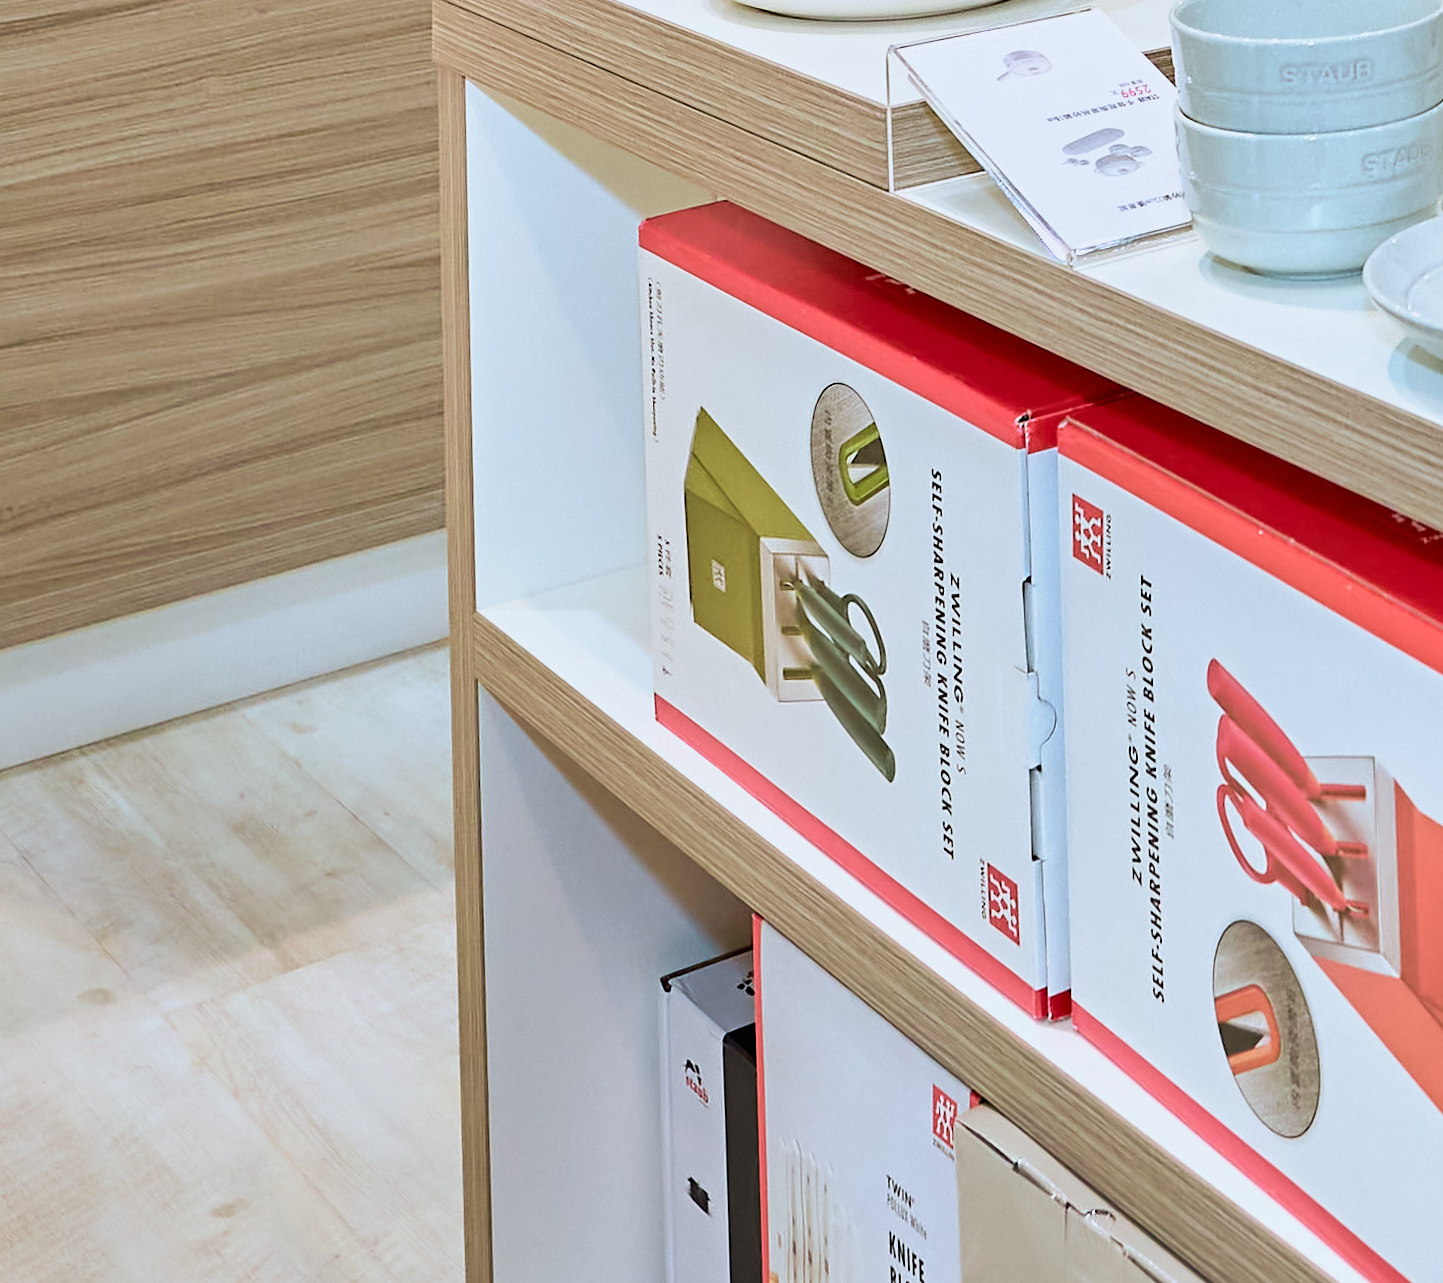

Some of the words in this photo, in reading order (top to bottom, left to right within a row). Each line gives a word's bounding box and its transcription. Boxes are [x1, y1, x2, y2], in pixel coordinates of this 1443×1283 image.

[1121, 83, 1152, 99] 2599
[1280, 58, 1374, 84] STAUB
[930, 468, 949, 666] SELF-SHARPENING
[1105, 514, 1113, 579] ZWILLING
[1140, 574, 1152, 620] SET
[950, 573, 964, 704] ZWILLING
[1126, 669, 1136, 679] S
[1142, 626, 1156, 701] BLOCK
[937, 673, 950, 735] KNIFE
[1126, 688, 1137, 727] NOW
[955, 717, 966, 757] NOW
[1144, 706, 1158, 780] KNIFE
[940, 737, 953, 809] BLOCK
[957, 763, 967, 775] S
[943, 820, 955, 860] SET
[1128, 746, 1143, 887] ZWILLING
[979, 858, 988, 920] ZWILLING
[1146, 788, 1165, 1003] SELF-SHARPENING
[685, 1076, 708, 1103] staub
[886, 1174, 913, 1209] TWIN
[887, 1193, 909, 1223] POLLUX
[889, 1231, 925, 1283] KNIFE
